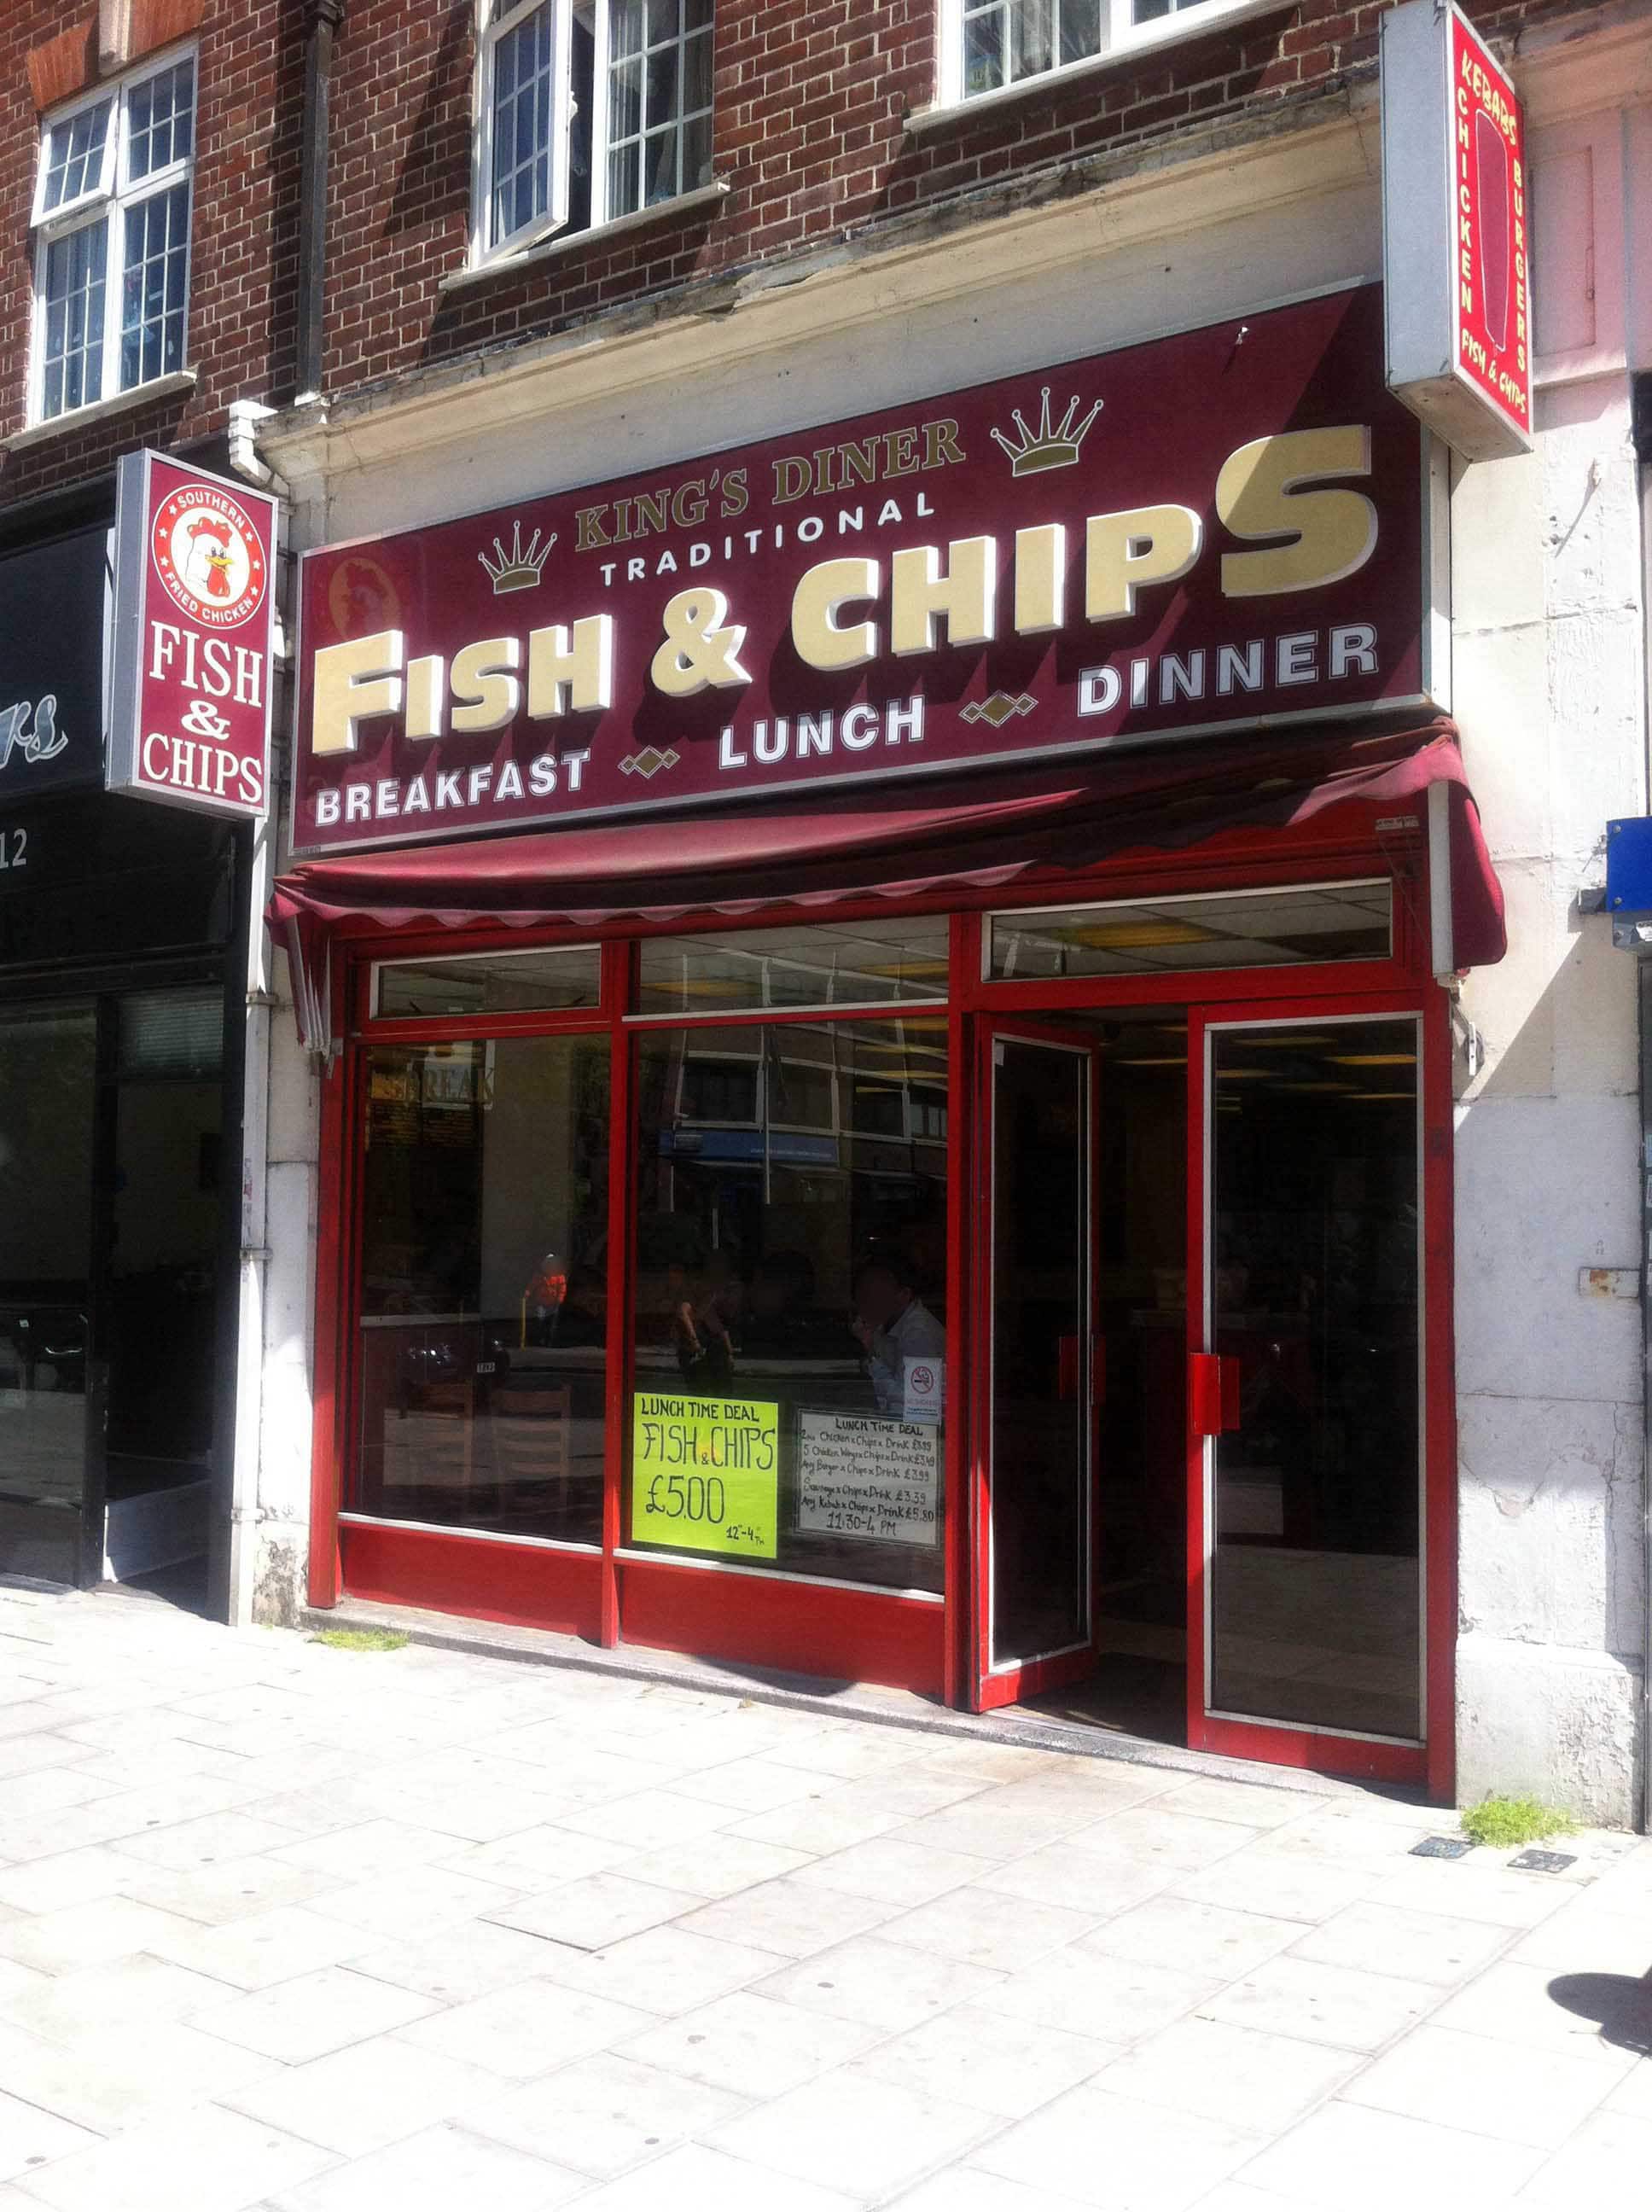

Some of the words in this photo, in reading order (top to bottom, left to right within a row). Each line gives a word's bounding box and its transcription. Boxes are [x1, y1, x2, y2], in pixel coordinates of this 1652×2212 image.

[1462, 49, 1516, 145] KEBABS
[1457, 86, 1473, 315] CHICKEN
[1514, 159, 1526, 372] BURGERS
[1462, 328, 1486, 375] FISH
[1488, 359, 1497, 383] &
[1499, 371, 1526, 414] CHIPS
[176, 490, 246, 530] SOUTHERN
[575, 469, 749, 552] KING'S
[771, 418, 966, 504] DINER
[600, 492, 934, 586] TRADITIONAL
[165, 571, 199, 614] FRIED
[201, 597, 253, 624] CHICKEN
[312, 613, 614, 757] FISH
[650, 586, 753, 697] &
[792, 423, 1379, 672] CHIPS
[149, 620, 263, 707] FISH
[181, 699, 231, 741] &
[315, 748, 590, 826] BREAKFAST
[718, 694, 926, 770] LUNCH
[1077, 622, 1379, 717] DINNER
[143, 732, 262, 803] CHIPS
[642, 1397, 683, 1417] LUNCH
[688, 1402, 719, 1420] TIME
[724, 1404, 759, 1422] DEAL
[642, 1423, 697, 1464] FISH
[711, 1426, 776, 1470] CHIPS
[835, 1417, 868, 1431] LUNCH
[899, 1423, 923, 1435] DEAL
[876, 1504, 904, 1518] Drink
[881, 1520, 896, 1536] PM
